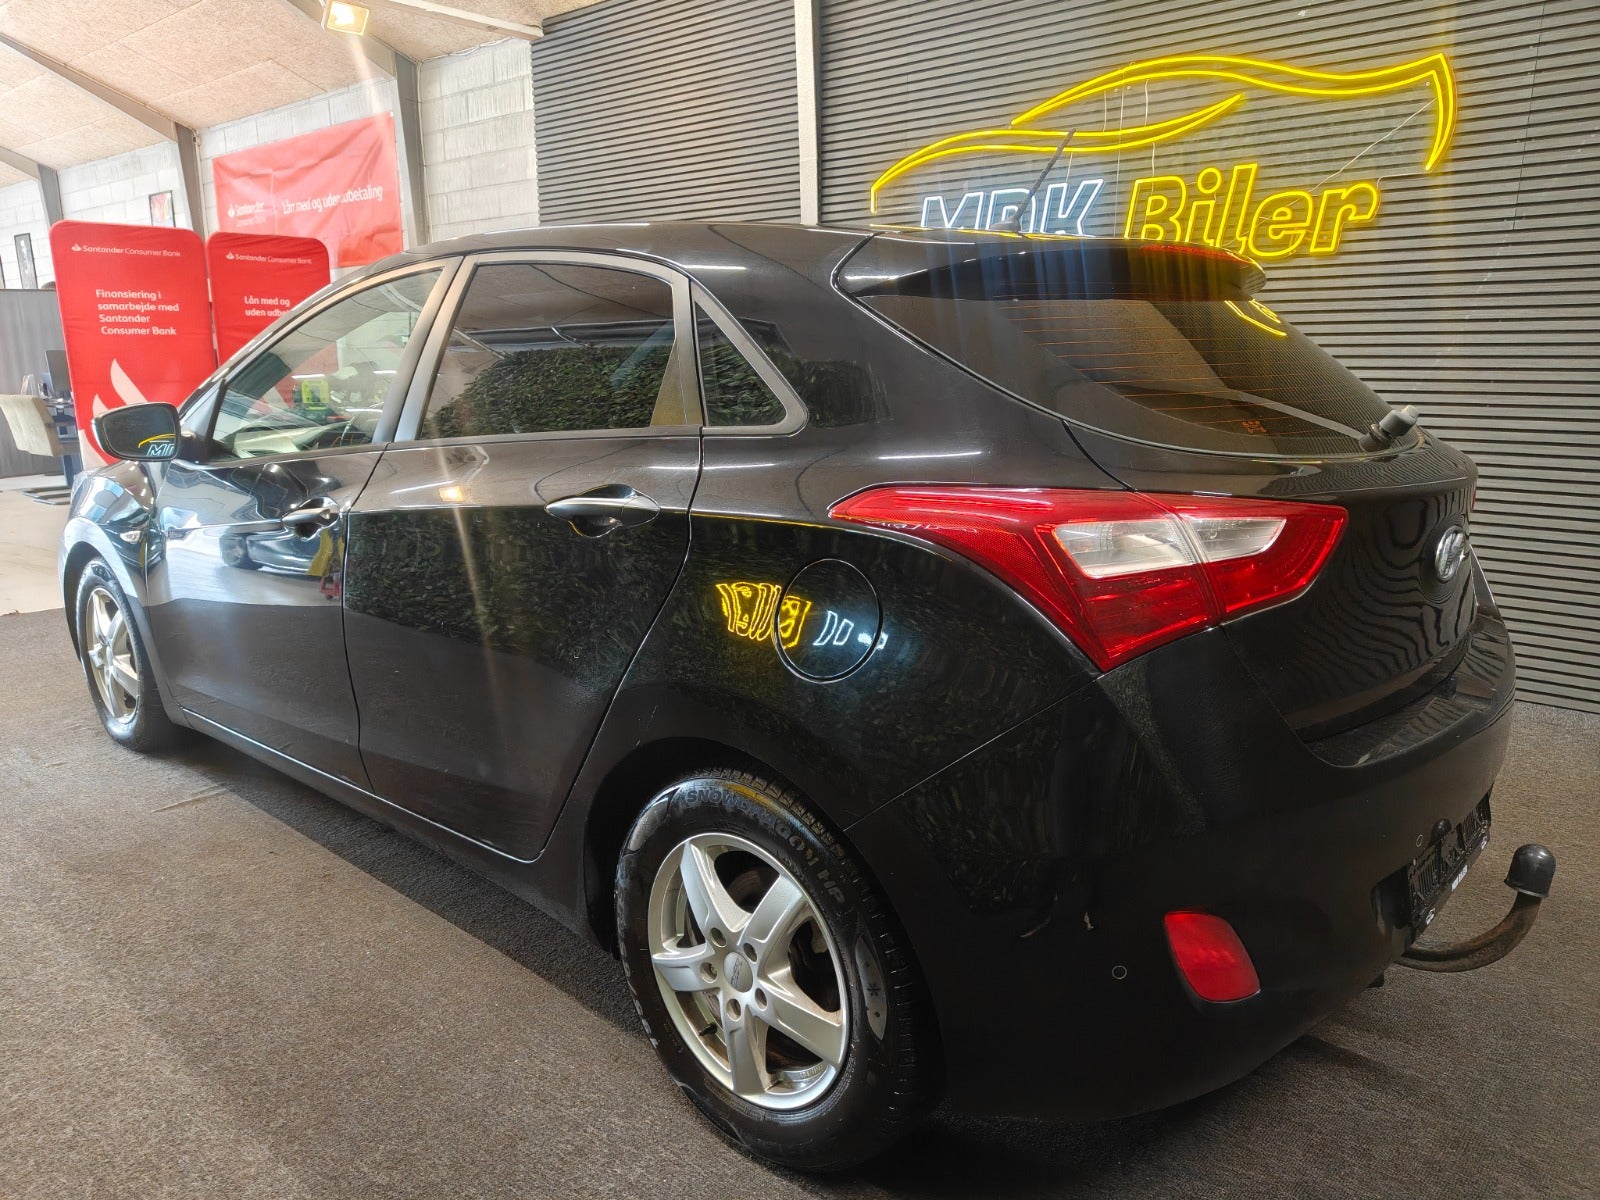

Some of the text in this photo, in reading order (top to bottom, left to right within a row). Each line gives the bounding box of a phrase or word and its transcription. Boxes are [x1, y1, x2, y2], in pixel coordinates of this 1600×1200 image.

[311, 197, 323, 213] og
[919, 162, 1380, 258] MDK Biler
[82, 245, 181, 257] Santander Consumer Bank
[95, 289, 157, 301] Finansiering
[97, 302, 179, 312] samarbejde med
[244, 295, 291, 308] Lån med og
[98, 314, 151, 323] Santander
[245, 308, 266, 317] uden
[100, 325, 177, 336] Consumer Bank
